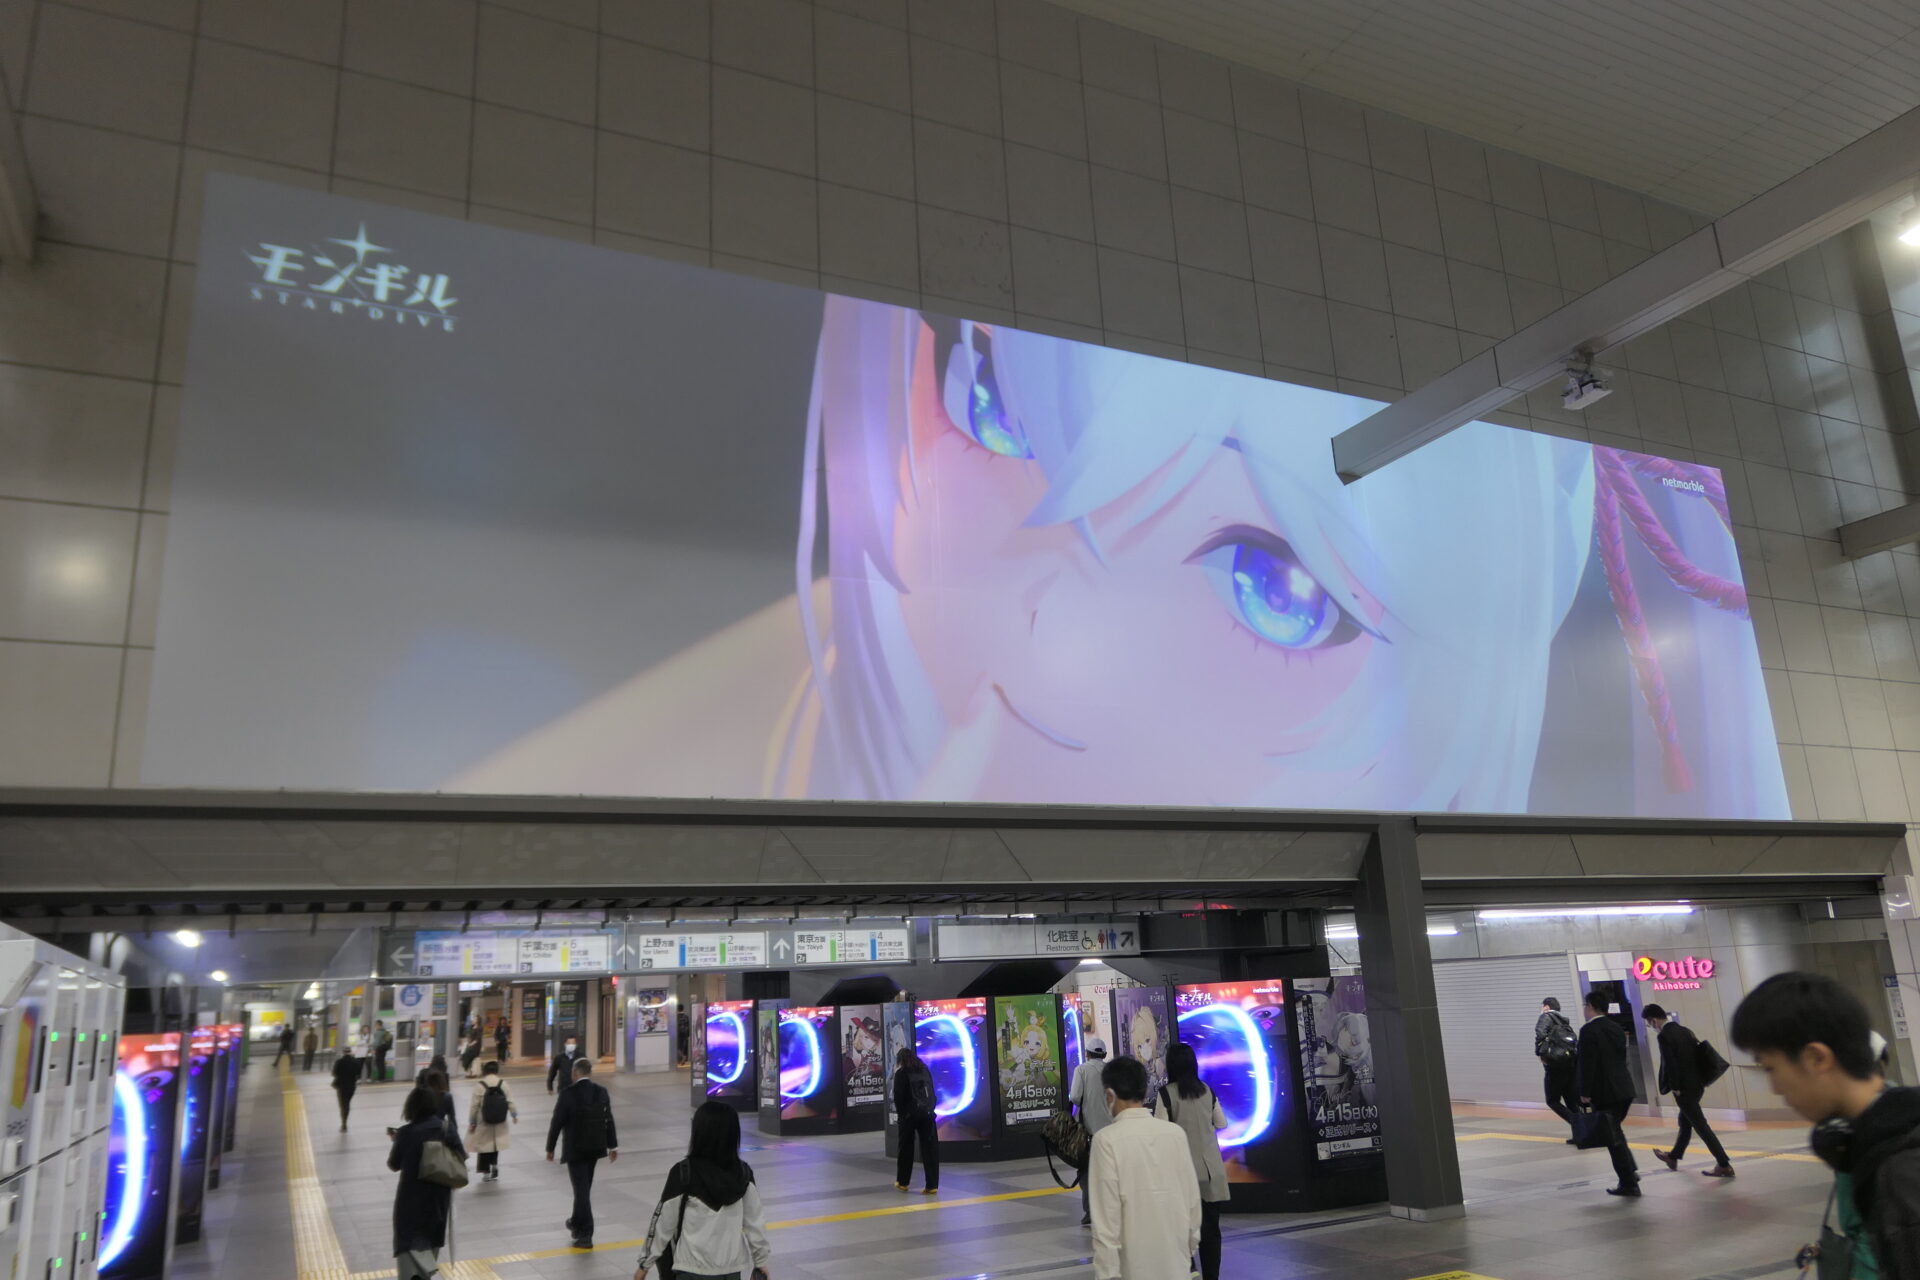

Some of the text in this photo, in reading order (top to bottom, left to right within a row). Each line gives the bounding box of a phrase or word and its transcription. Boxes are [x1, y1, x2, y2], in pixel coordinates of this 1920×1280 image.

[245, 240, 458, 310] モンギル
[250, 287, 455, 333] STAR DIVE
[1662, 477, 1705, 493] netmarble
[688, 936, 693, 945] 1
[727, 935, 734, 945] 2
[837, 932, 843, 942] 3
[877, 931, 884, 940] 4
[1047, 929, 1079, 943] 化粧室
[1046, 944, 1080, 952] Restrooms
[1632, 955, 1714, 981] ecute
[1653, 981, 1701, 991] Akihabara
[1180, 992, 1212, 1002] モンギル
[1006, 1085, 1057, 1099] 4月15日(水)
[1315, 1103, 1378, 1124] 4月15日(水)
